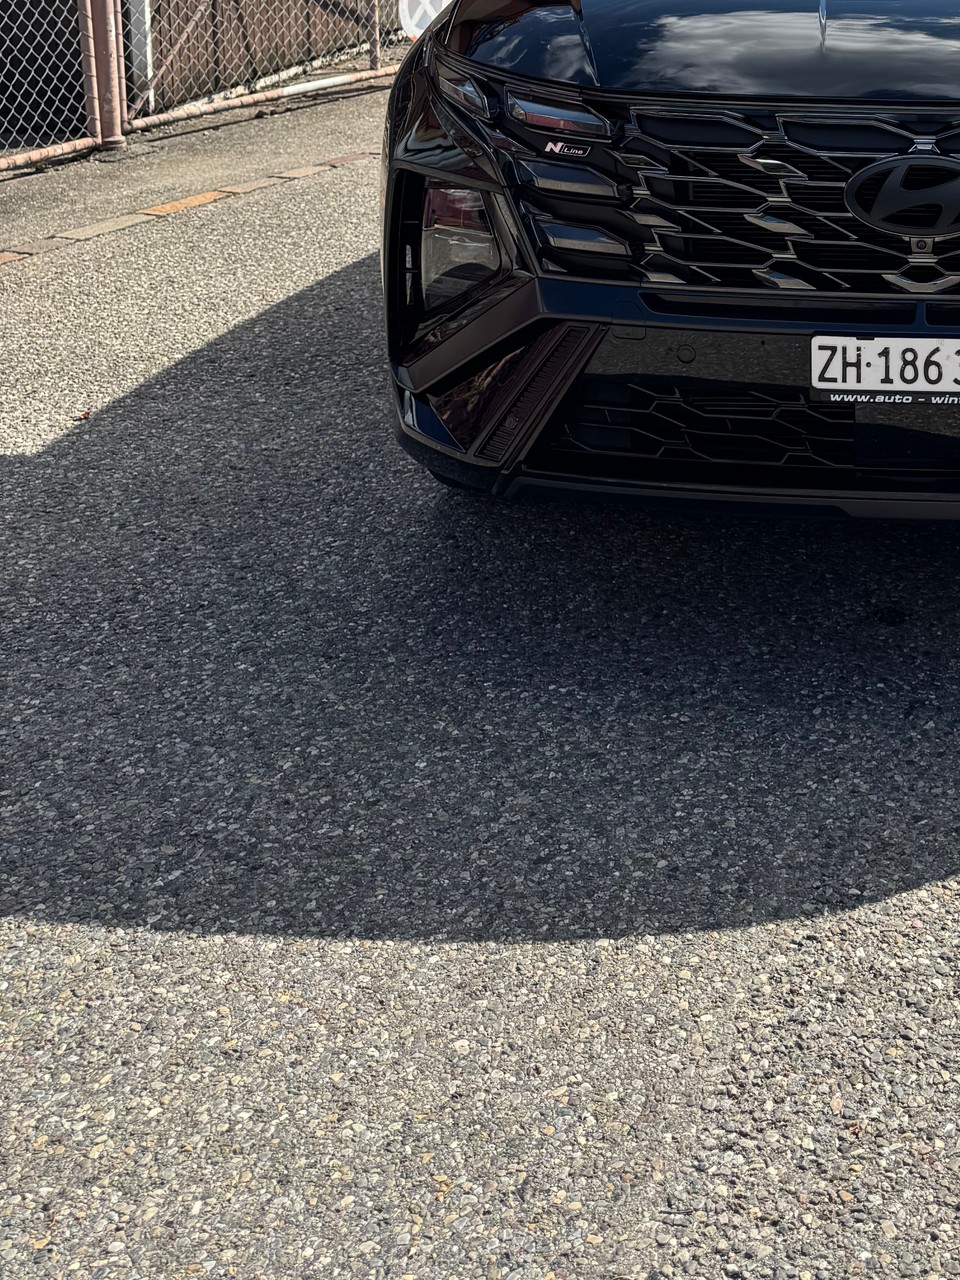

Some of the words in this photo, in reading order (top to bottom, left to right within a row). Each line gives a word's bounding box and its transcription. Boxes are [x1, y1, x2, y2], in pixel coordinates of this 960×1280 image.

[544, 141, 564, 153] N
[564, 146, 583, 155] Line
[830, 393, 912, 404] www.auto
